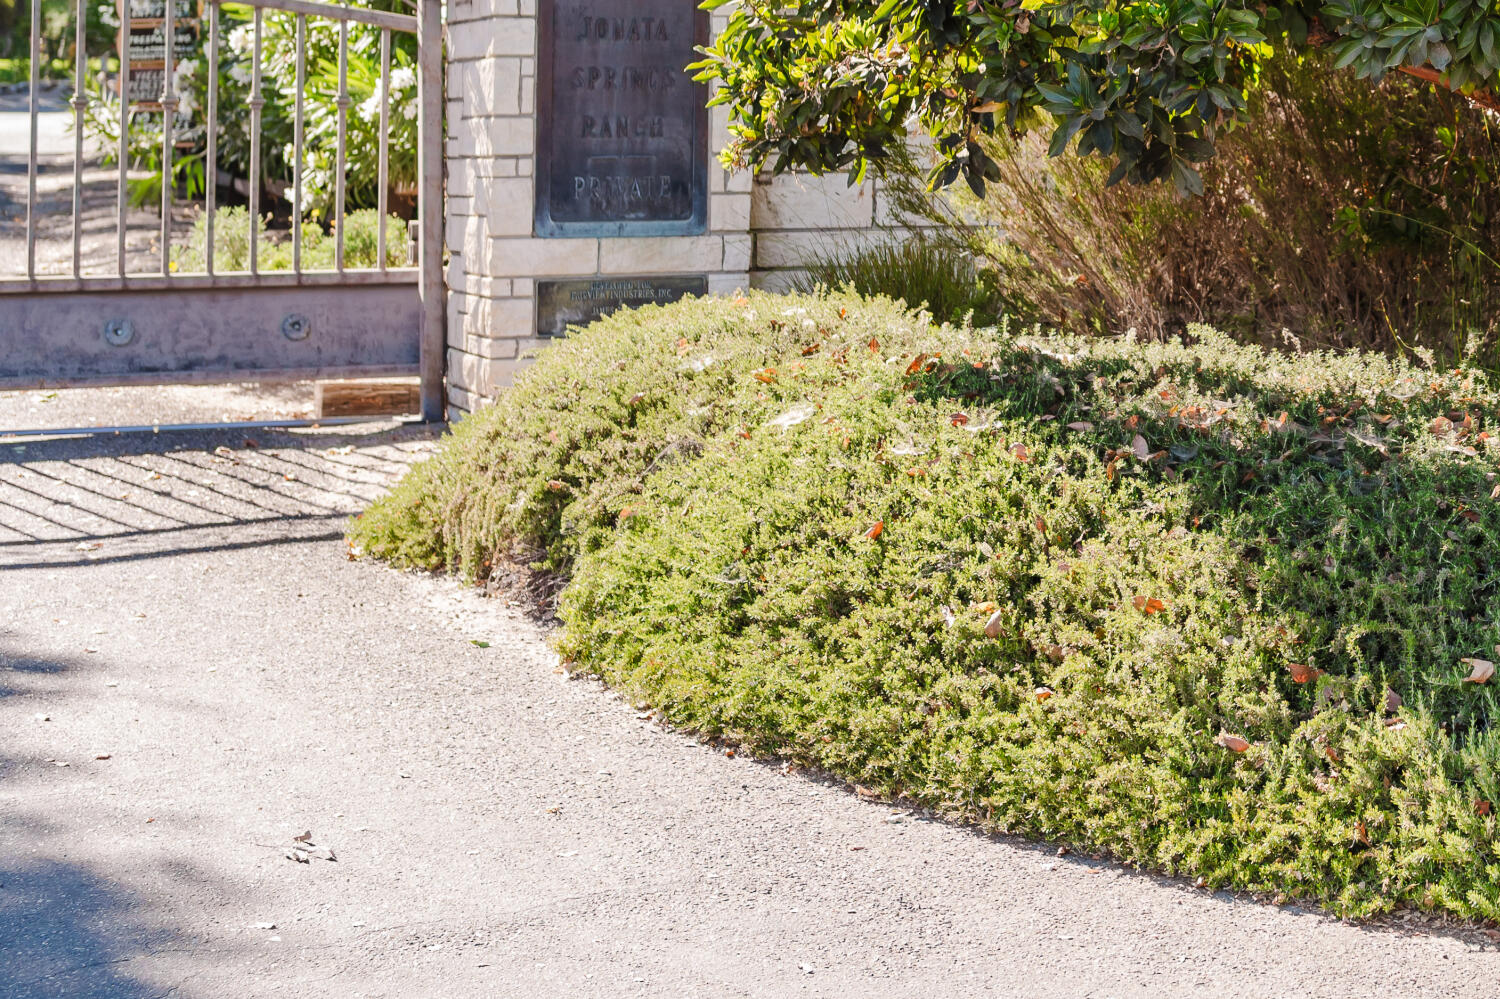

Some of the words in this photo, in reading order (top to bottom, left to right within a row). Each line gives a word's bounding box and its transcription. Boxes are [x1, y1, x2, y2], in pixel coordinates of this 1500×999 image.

[577, 16, 670, 42] JONATA
[571, 65, 677, 92] SPRINGS
[580, 114, 664, 139] RANCH
[573, 175, 673, 200] PRIVATE
